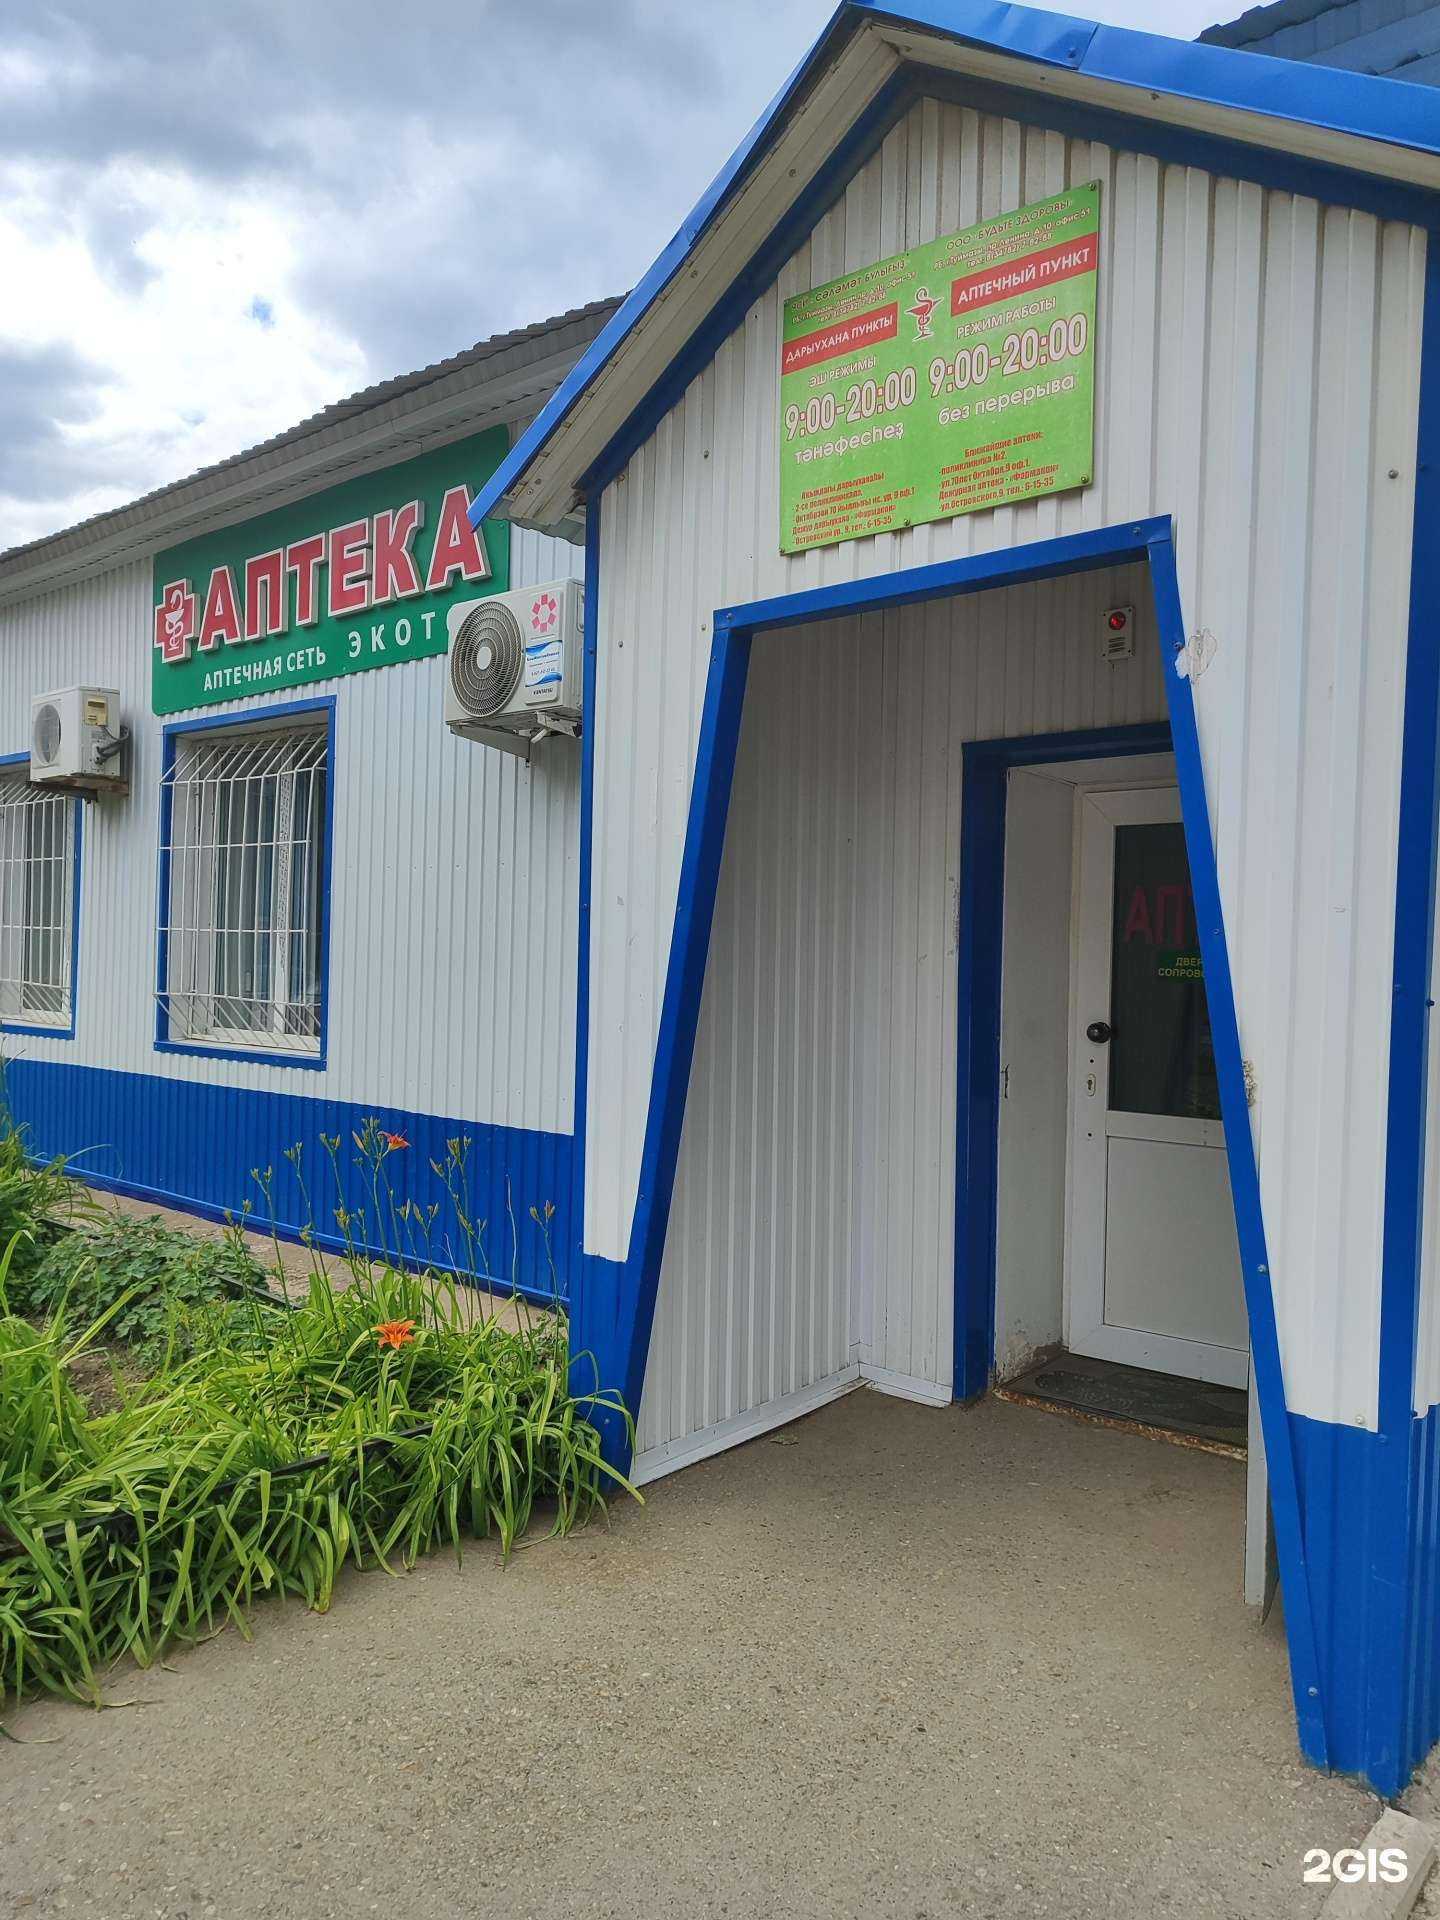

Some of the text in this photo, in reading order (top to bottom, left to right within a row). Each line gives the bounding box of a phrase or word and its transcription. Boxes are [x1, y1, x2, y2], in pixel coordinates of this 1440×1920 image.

[946, 235, 971, 250] ООО
[957, 248, 1090, 305] АПТЕЧНЫЙ ПУНКТ
[785, 314, 893, 364] ДАРЫУХАНА ПУНКТЫ
[956, 297, 1057, 339] РЕЖИМ РАБОТЫ
[829, 355, 877, 381] РЕЖИМЫ
[928, 312, 1088, 398] 9:00-20:00
[784, 366, 917, 441] 9:00-20:00
[938, 375, 1075, 425] без перерыва
[197, 484, 492, 652] АПТЕКА
[203, 611, 437, 692] АПТЕЧНАЯ СЕТЬ ЭКОТ
[1121, 885, 1198, 949] АП
[1158, 967, 1205, 978] СОПРОВ
